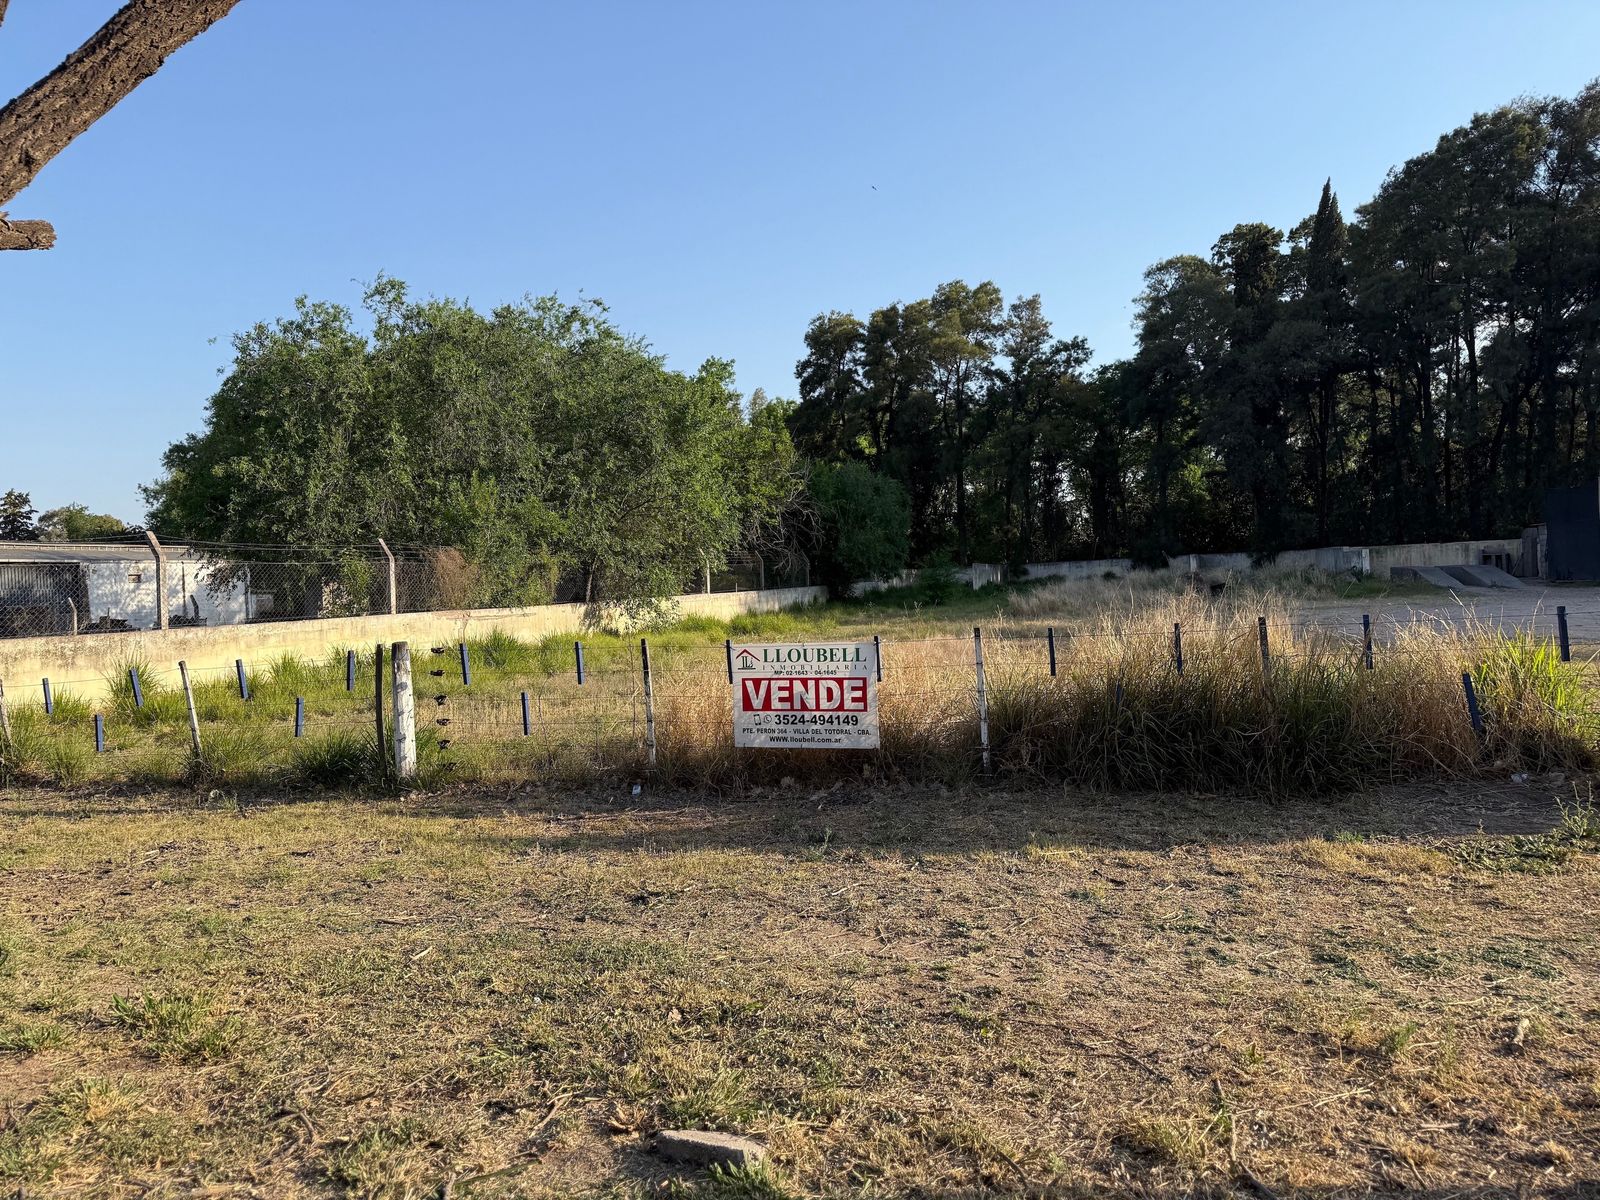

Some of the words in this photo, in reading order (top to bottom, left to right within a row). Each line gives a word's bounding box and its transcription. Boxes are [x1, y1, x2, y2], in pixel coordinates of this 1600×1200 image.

[763, 648, 867, 662] LLOUBELL
[744, 680, 864, 710] VENDE
[774, 714, 859, 726] 3524-494149
